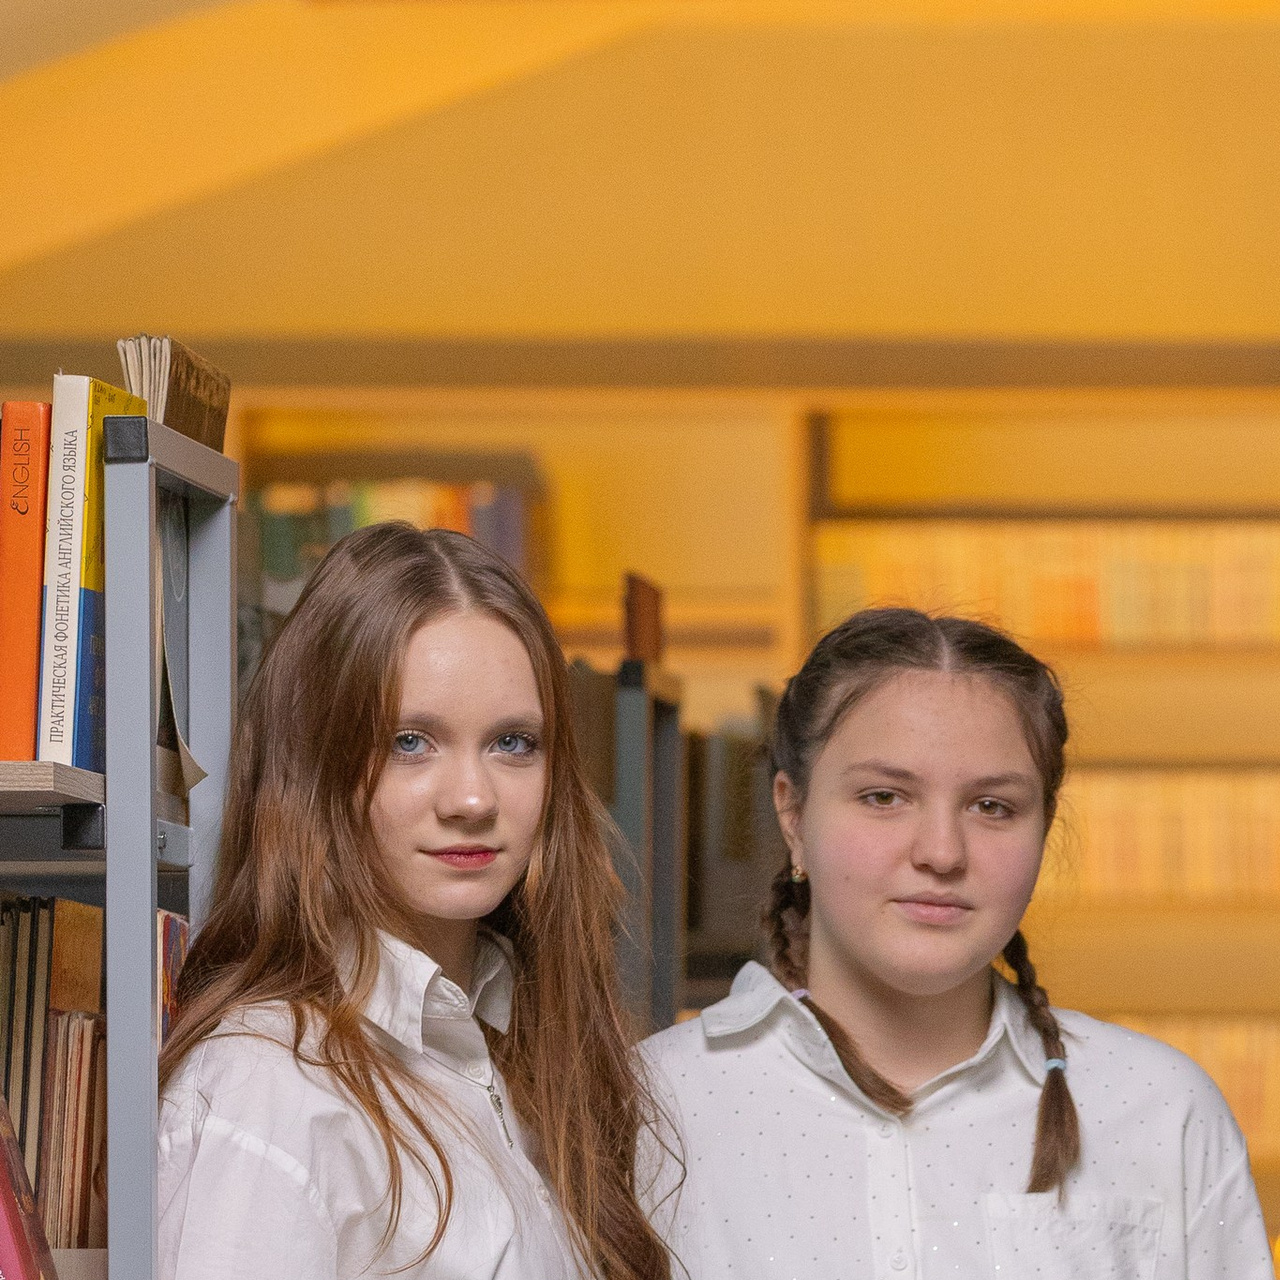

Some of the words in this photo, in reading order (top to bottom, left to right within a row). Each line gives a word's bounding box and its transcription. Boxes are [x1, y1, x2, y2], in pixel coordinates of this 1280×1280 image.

[10, 428, 30, 515] ENGLISH
[62, 429, 78, 473] ЯЗЫКА
[57, 475, 75, 570] АНГЛИЙСКОГО
[54, 572, 71, 642] ФОНЕТИКА
[49, 645, 68, 743] ПРАКТИЧЕСКАЯ
